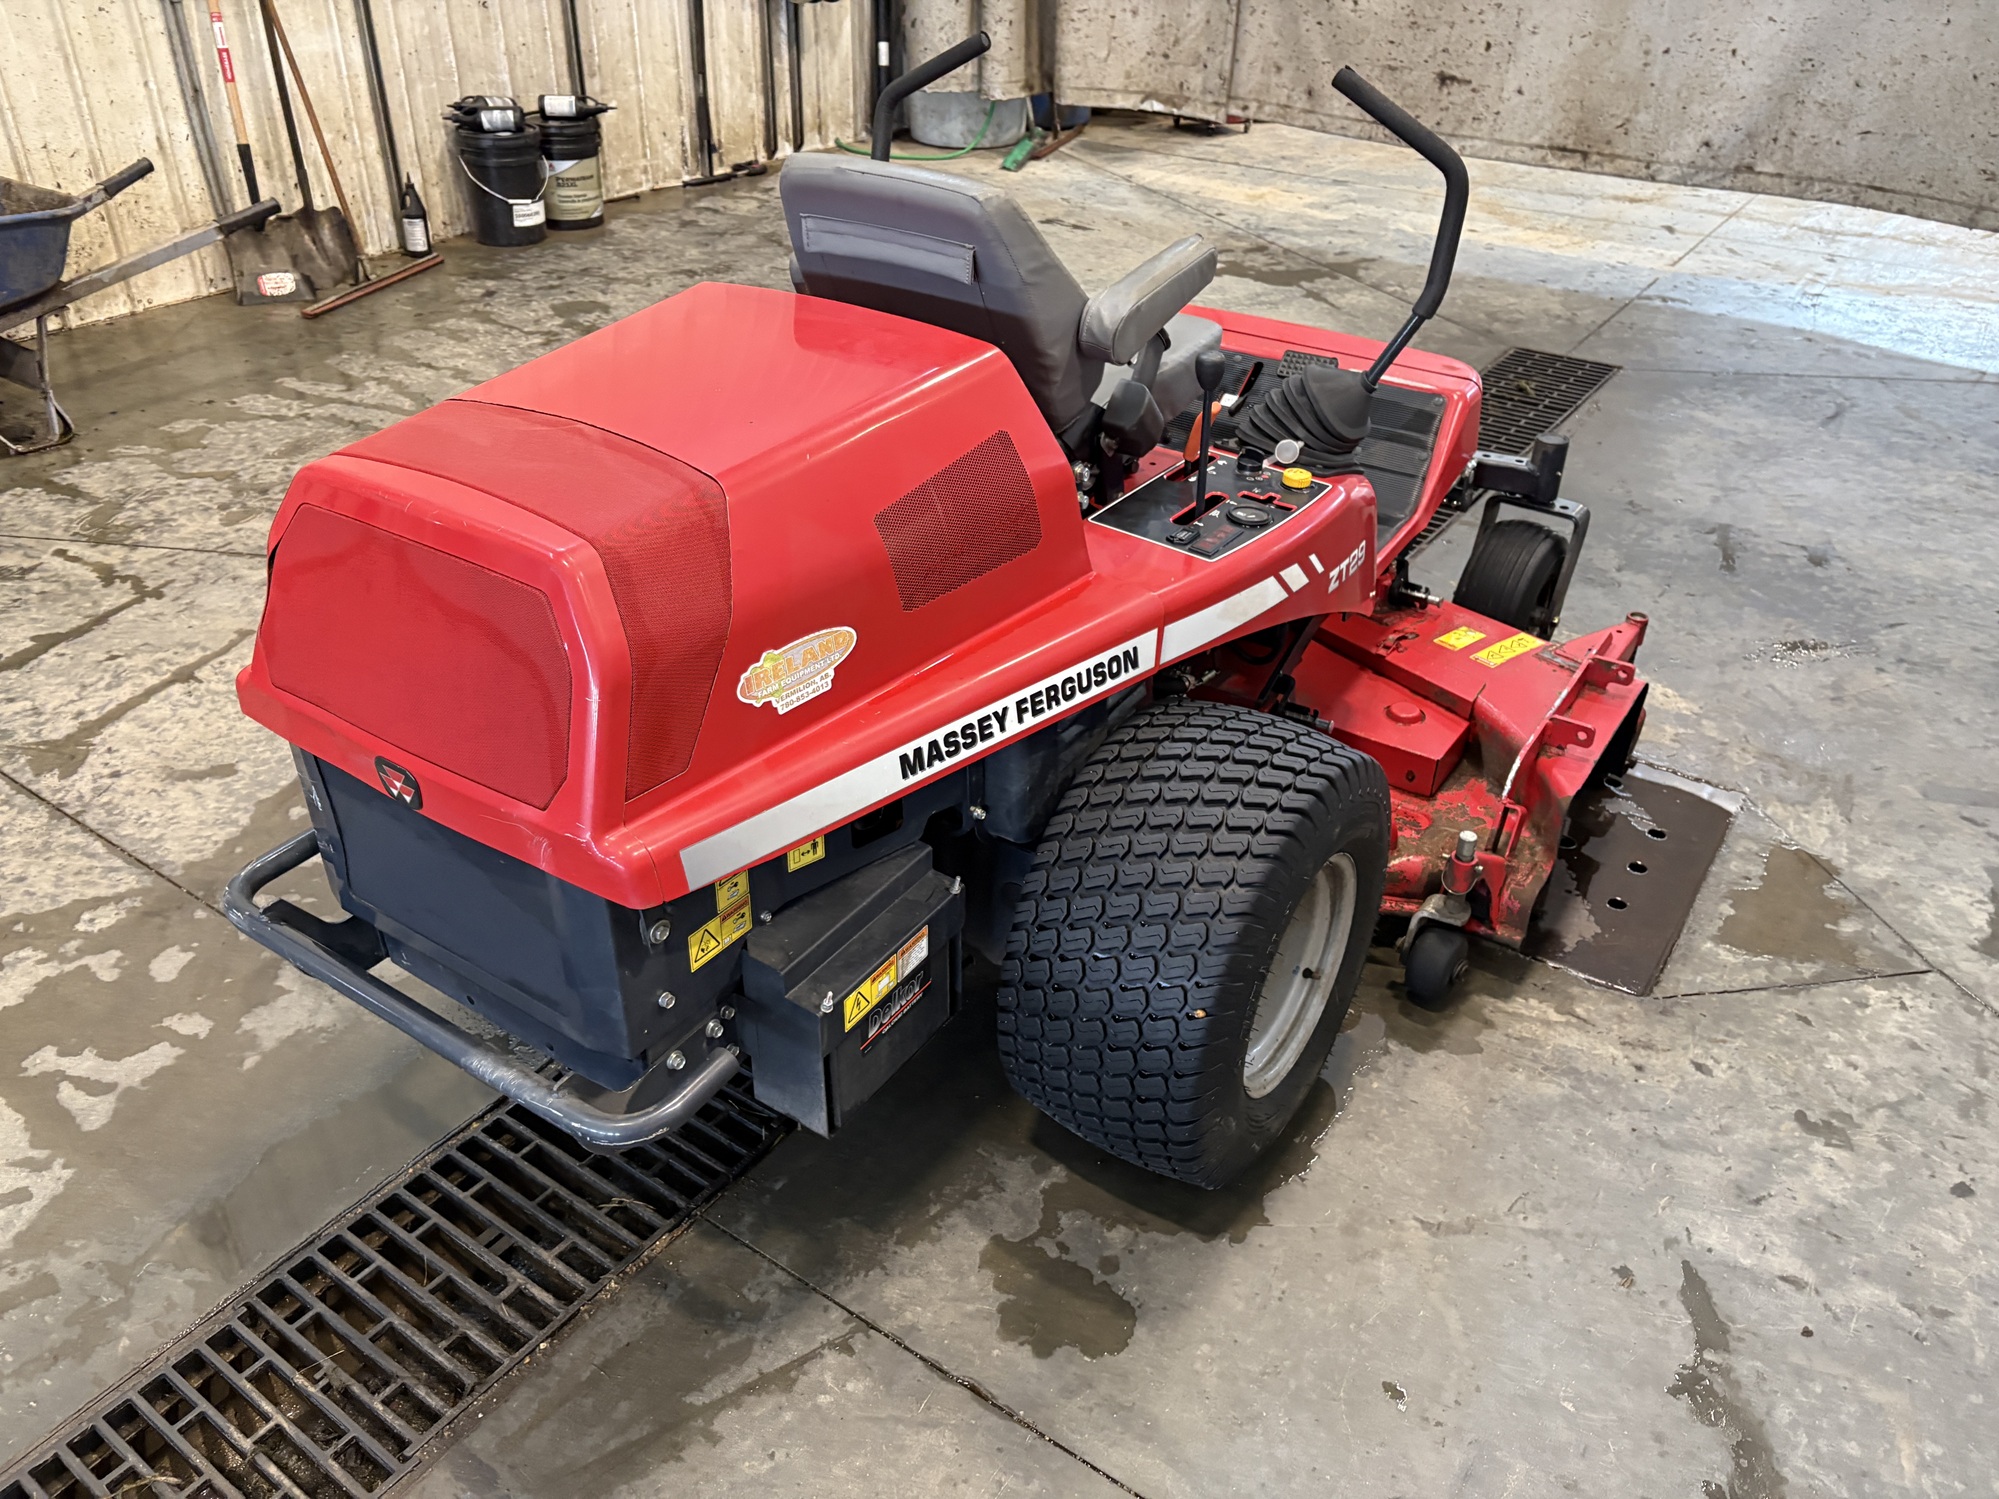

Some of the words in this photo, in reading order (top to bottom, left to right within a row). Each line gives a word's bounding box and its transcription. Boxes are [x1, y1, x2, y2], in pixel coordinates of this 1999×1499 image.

[1328, 540, 1366, 594] ZT29
[743, 631, 849, 696] IRELAND
[757, 684, 779, 698] FARM
[781, 660, 828, 687] EQUIPMENT
[827, 653, 842, 668] LTD.
[775, 680, 819, 705] VERMILION,
[819, 672, 832, 683] AB.
[779, 682, 830, 711] 780-853-4013
[898, 706, 1009, 780] MASSEY
[1016, 646, 1140, 725] FERGUSON
[868, 971, 924, 1038] Delkor
